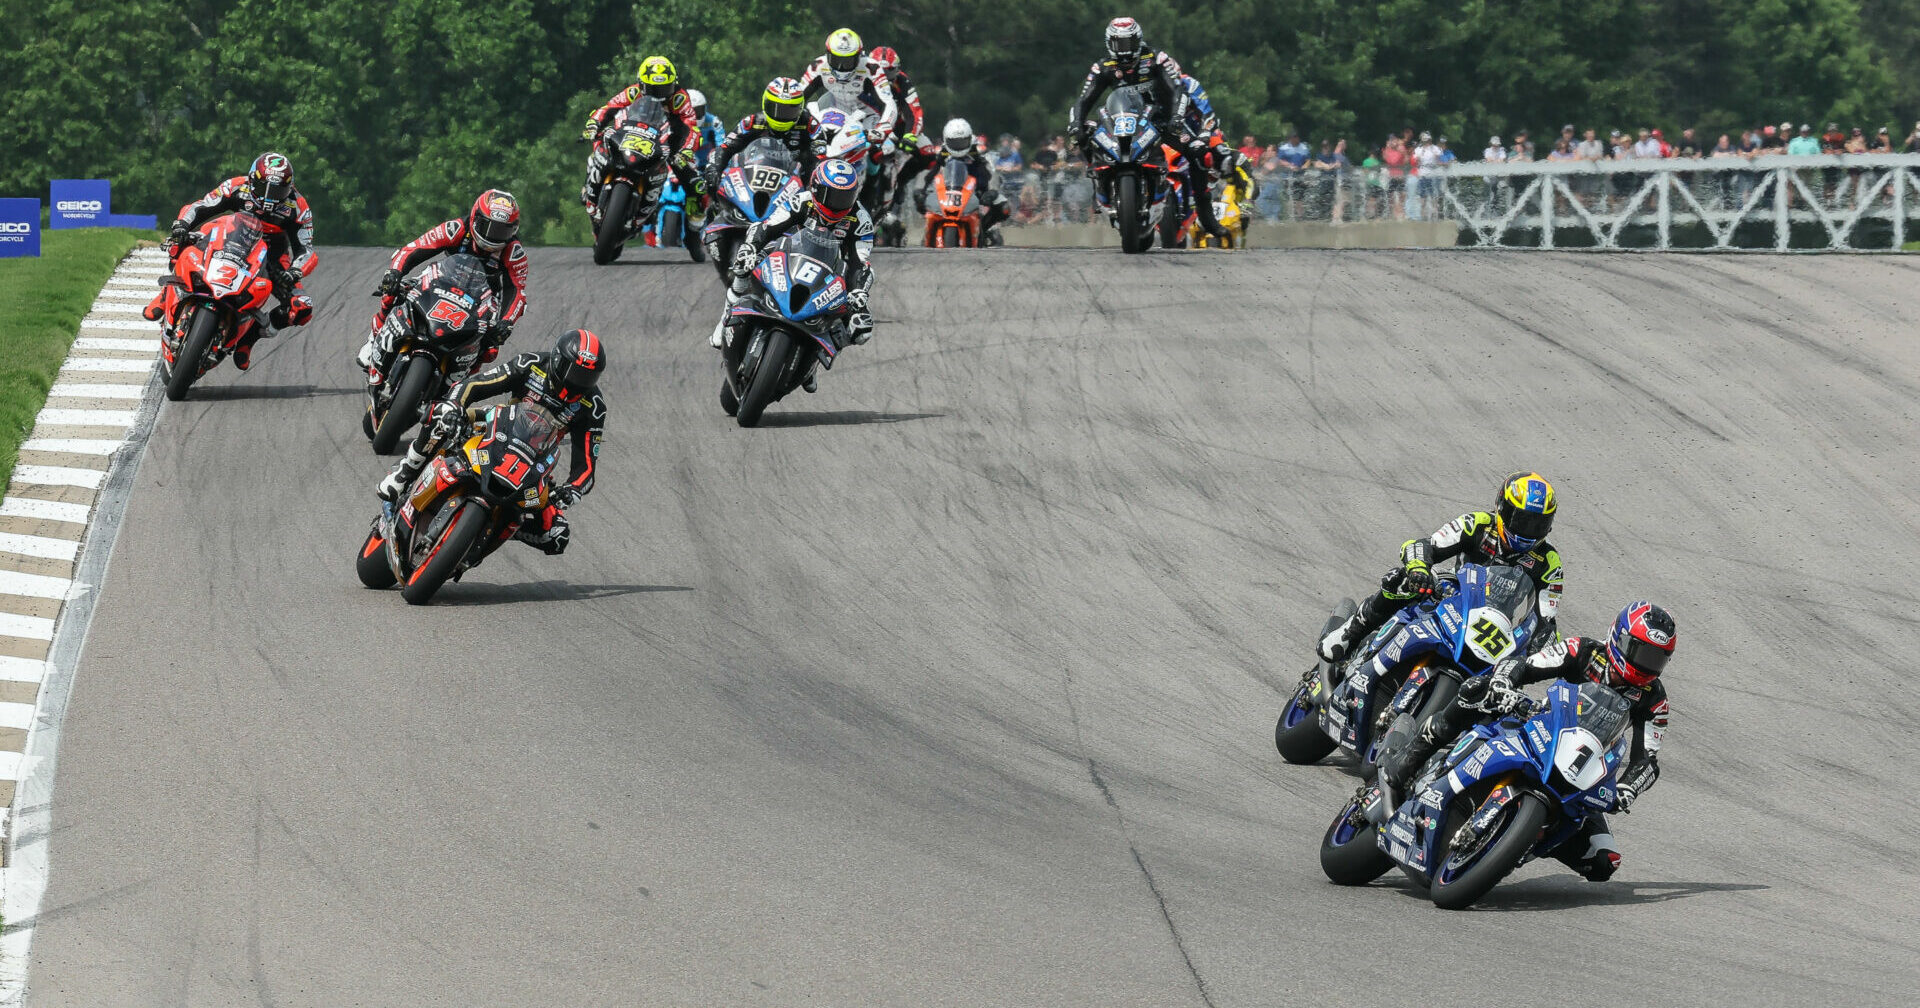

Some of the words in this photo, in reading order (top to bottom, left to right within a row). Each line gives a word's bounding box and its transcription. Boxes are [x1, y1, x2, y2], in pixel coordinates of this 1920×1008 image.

[1114, 116, 1136, 135] 23
[620, 133, 655, 157] 24
[751, 169, 782, 190] 99
[57, 200, 102, 211] GEICO
[209, 265, 239, 290] 2
[795, 261, 822, 284] 6
[434, 288, 473, 310] SUZUKI
[811, 281, 842, 306] TYTLERS
[426, 299, 470, 331] 54
[494, 453, 531, 490] 11
[1441, 612, 1458, 634] YAMAHA
[1471, 617, 1512, 659] 45
[1652, 631, 1667, 642] Arai
[1529, 730, 1546, 753] YAMAHA
[1568, 744, 1594, 777] 1
